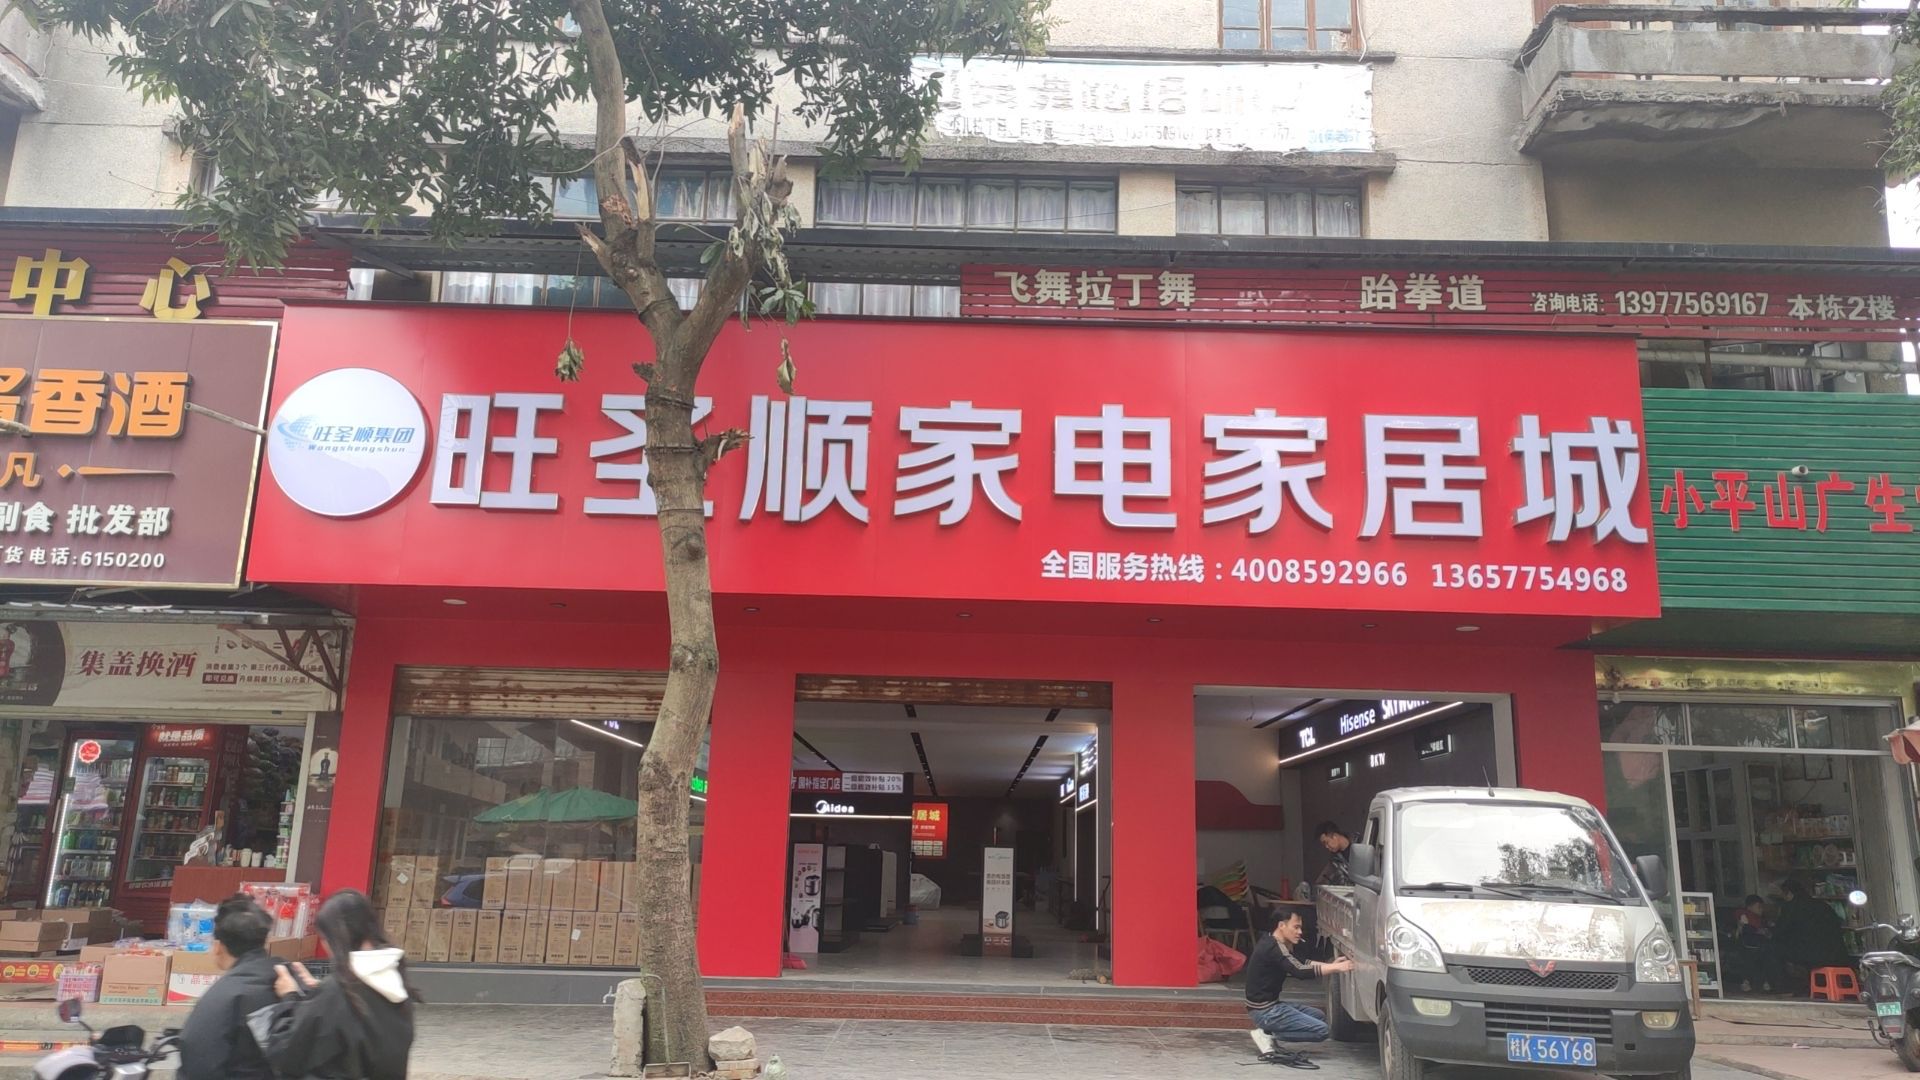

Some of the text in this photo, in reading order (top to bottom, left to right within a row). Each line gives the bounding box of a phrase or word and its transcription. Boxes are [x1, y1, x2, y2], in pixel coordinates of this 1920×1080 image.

[9, 248, 211, 319] 中心
[994, 268, 1197, 307] 飞舞拉丁舞
[1359, 273, 1487, 311] 跆拳道
[1614, 290, 1769, 316] 13977569167
[1787, 294, 1897, 321] 本栋2楼
[313, 425, 415, 444] 旺圣顺集团
[1660, 468, 1920, 533] 小平山广生
[66, 504, 170, 536] 批发部
[0, 546, 164, 568] 货电话:6150200
[1431, 563, 1628, 592] 13657754968
[75, 650, 198, 677] 集盖换酒
[1299, 726, 1315, 748] TCL
[1340, 708, 1376, 735] Hisense
[815, 800, 855, 814] Midea
